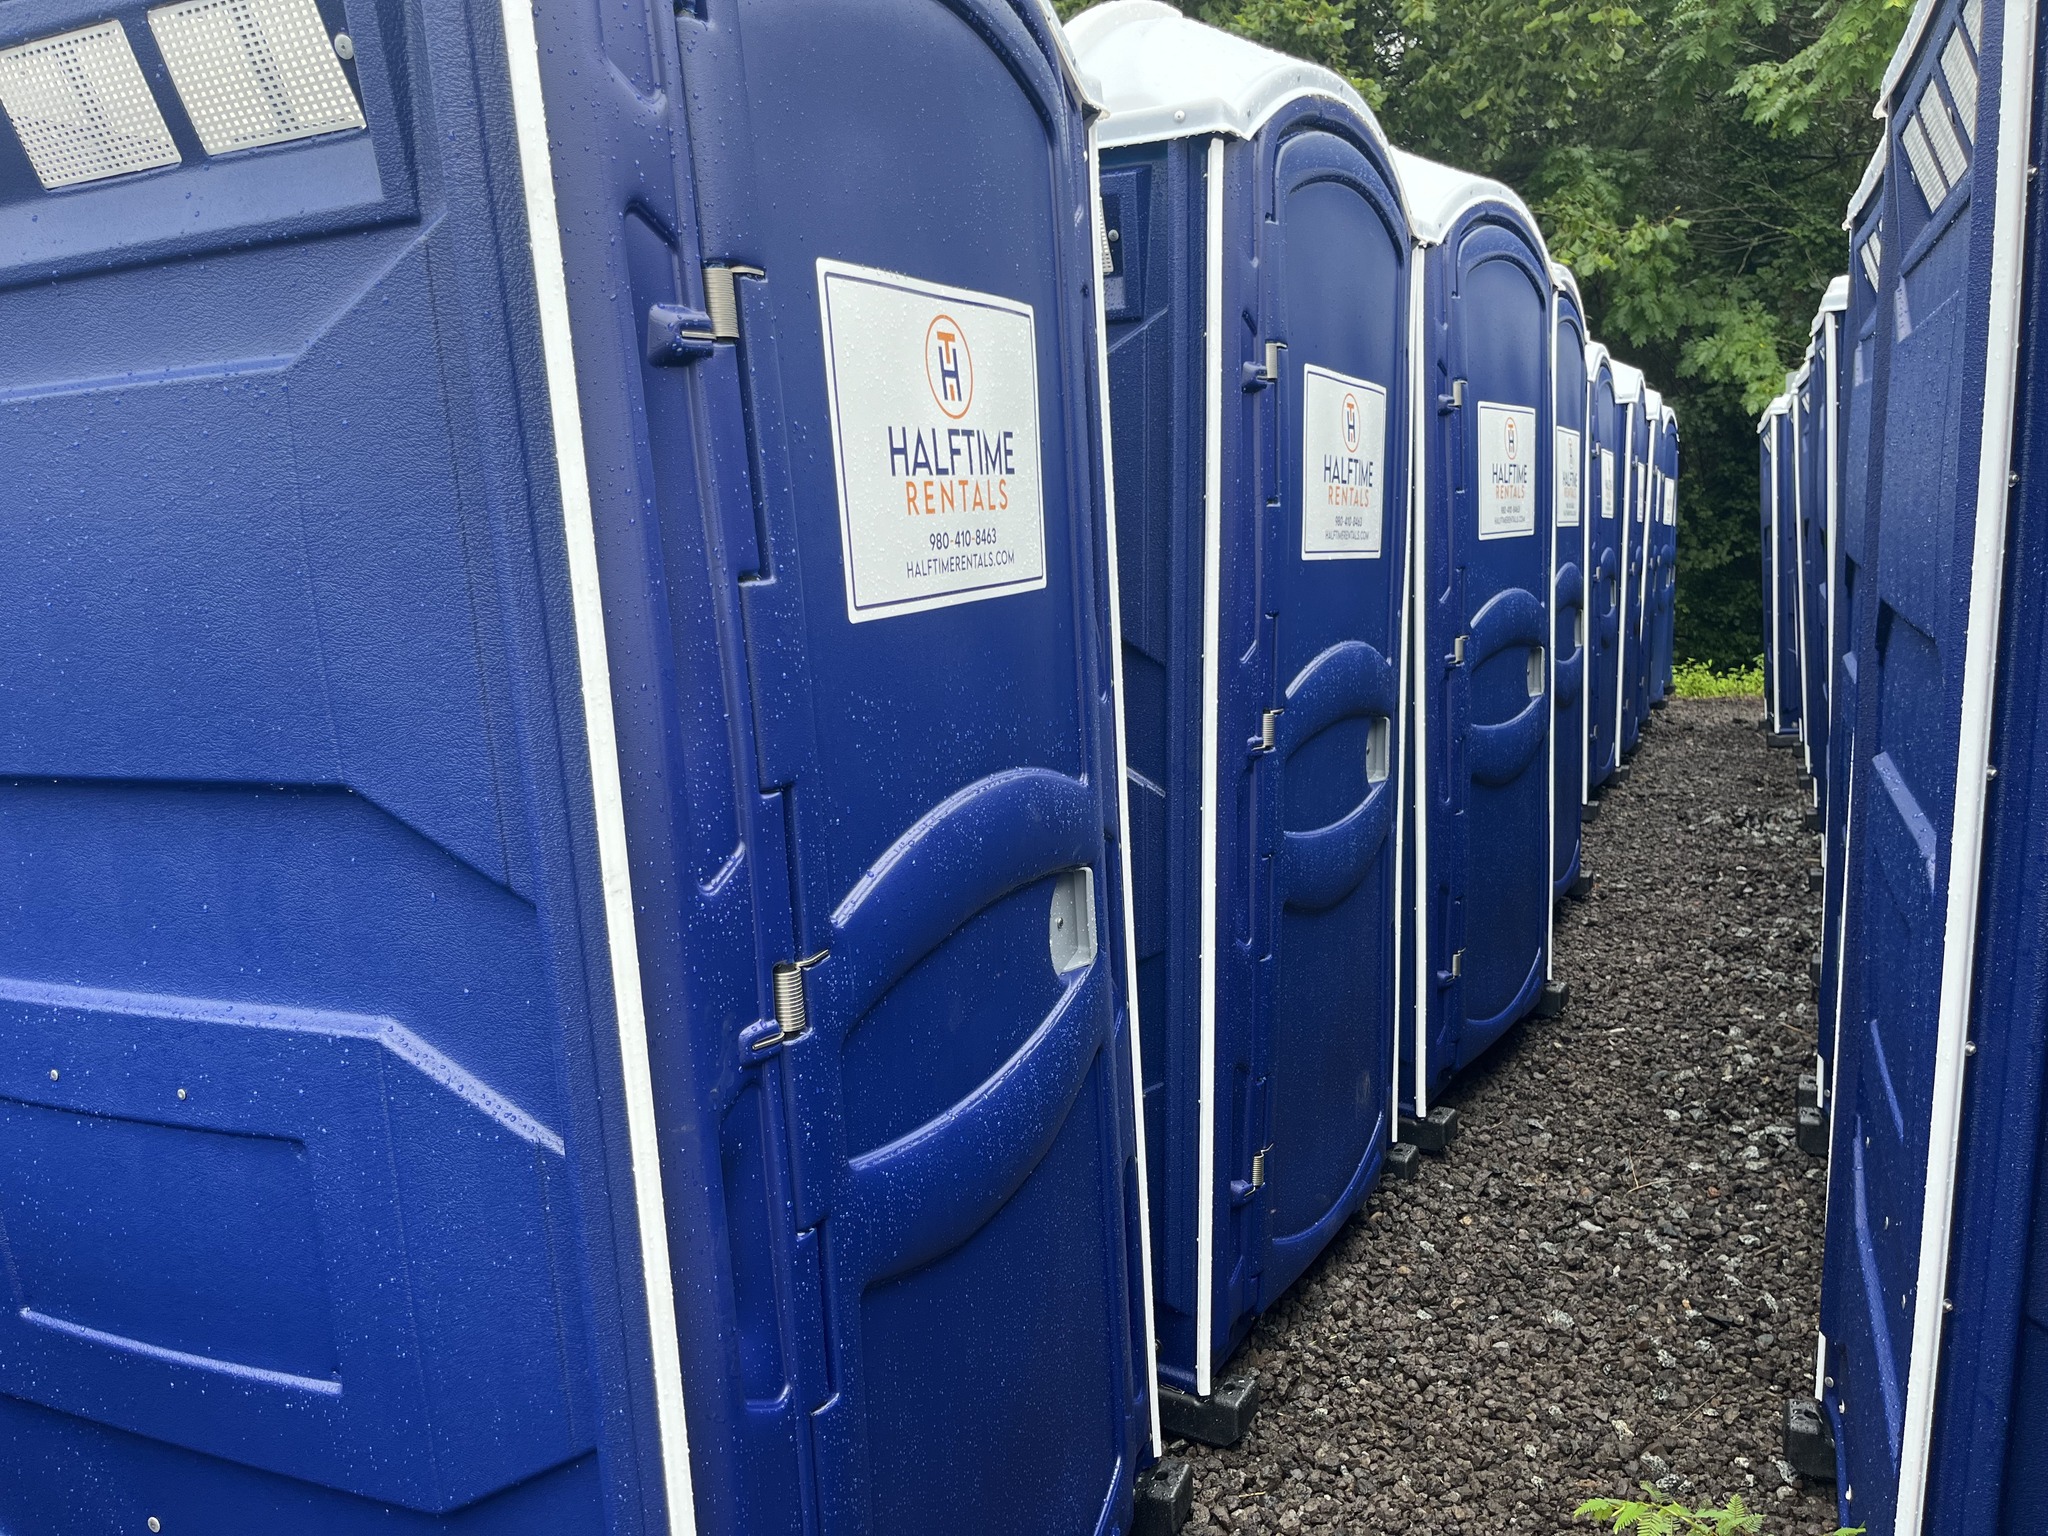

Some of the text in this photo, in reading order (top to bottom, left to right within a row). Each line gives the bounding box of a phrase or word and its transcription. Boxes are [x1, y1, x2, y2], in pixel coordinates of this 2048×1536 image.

[887, 425, 1016, 477] HALFTIME
[1323, 454, 1374, 488] HALFTIME
[1492, 463, 1527, 484] HALFTIME
[905, 478, 1009, 516] RENTALS
[1327, 485, 1370, 508] RENTALS
[1495, 485, 1525, 500] RENTALS
[929, 527, 997, 551] 980-410-8463
[906, 549, 1015, 579] HALFTIMERENTALS.COM
